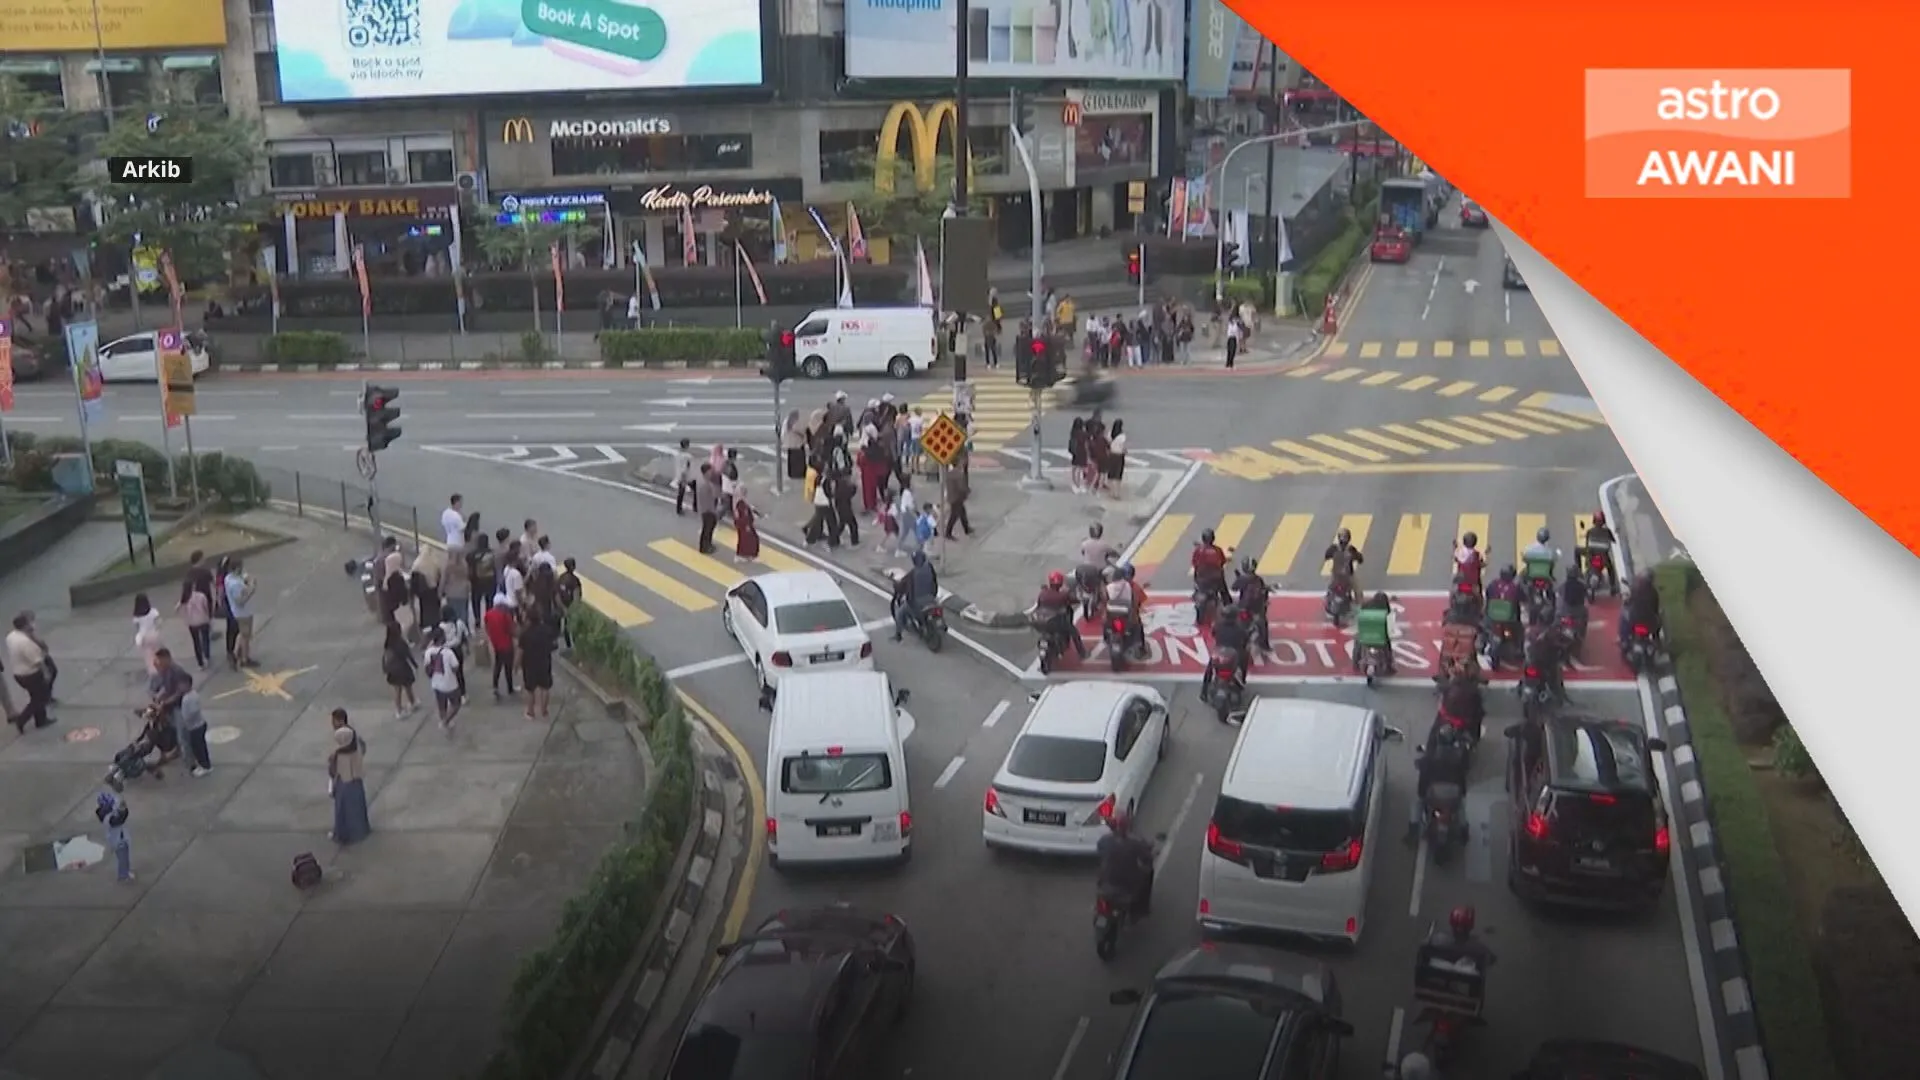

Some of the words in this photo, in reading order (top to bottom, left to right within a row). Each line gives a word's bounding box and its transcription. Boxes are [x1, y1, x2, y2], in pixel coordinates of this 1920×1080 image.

[538, 1, 576, 27] Book
[579, 10, 592, 31] A
[596, 13, 641, 41] Spot
[550, 117, 672, 137] McDonald's
[359, 198, 419, 215] BAKE
[692, 183, 772, 208] Pasembor
